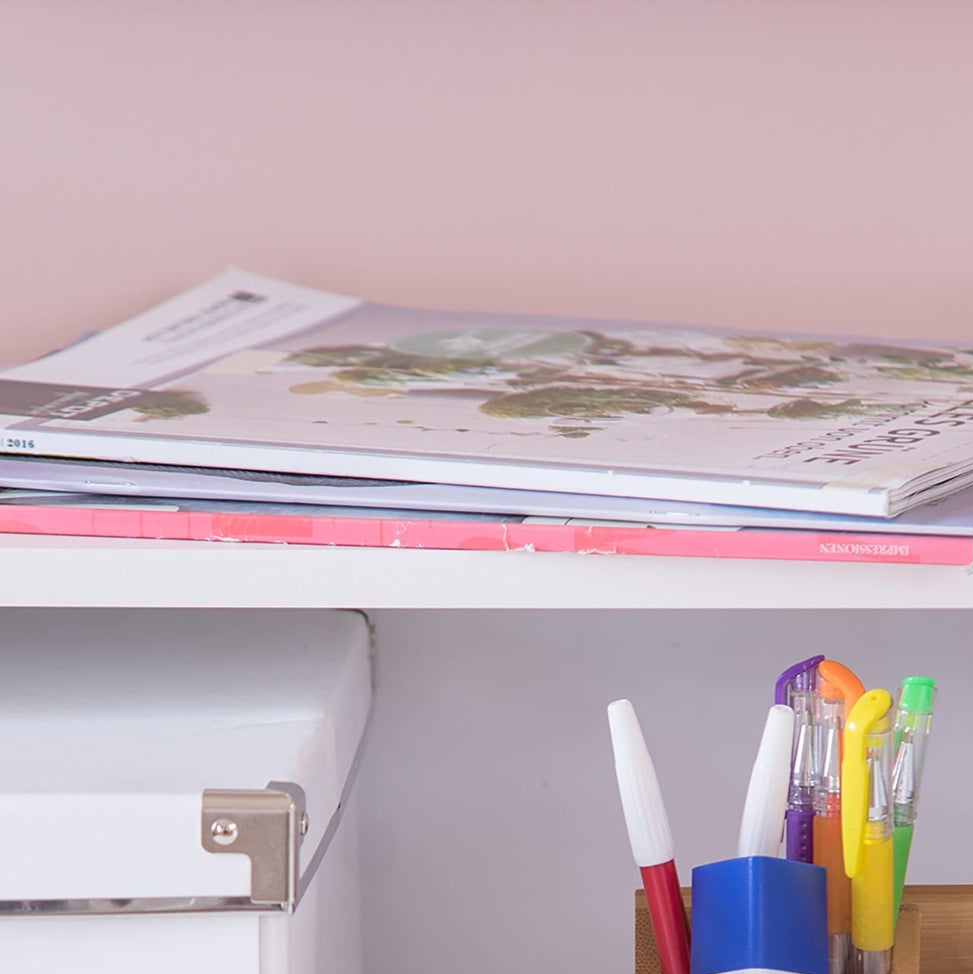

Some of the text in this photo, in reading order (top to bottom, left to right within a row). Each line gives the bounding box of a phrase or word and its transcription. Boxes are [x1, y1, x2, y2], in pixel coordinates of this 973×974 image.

[7, 438, 35, 449] 2016
[803, 428, 941, 466] GRÜNE
[819, 543, 910, 555] IMPRESSIONEN
